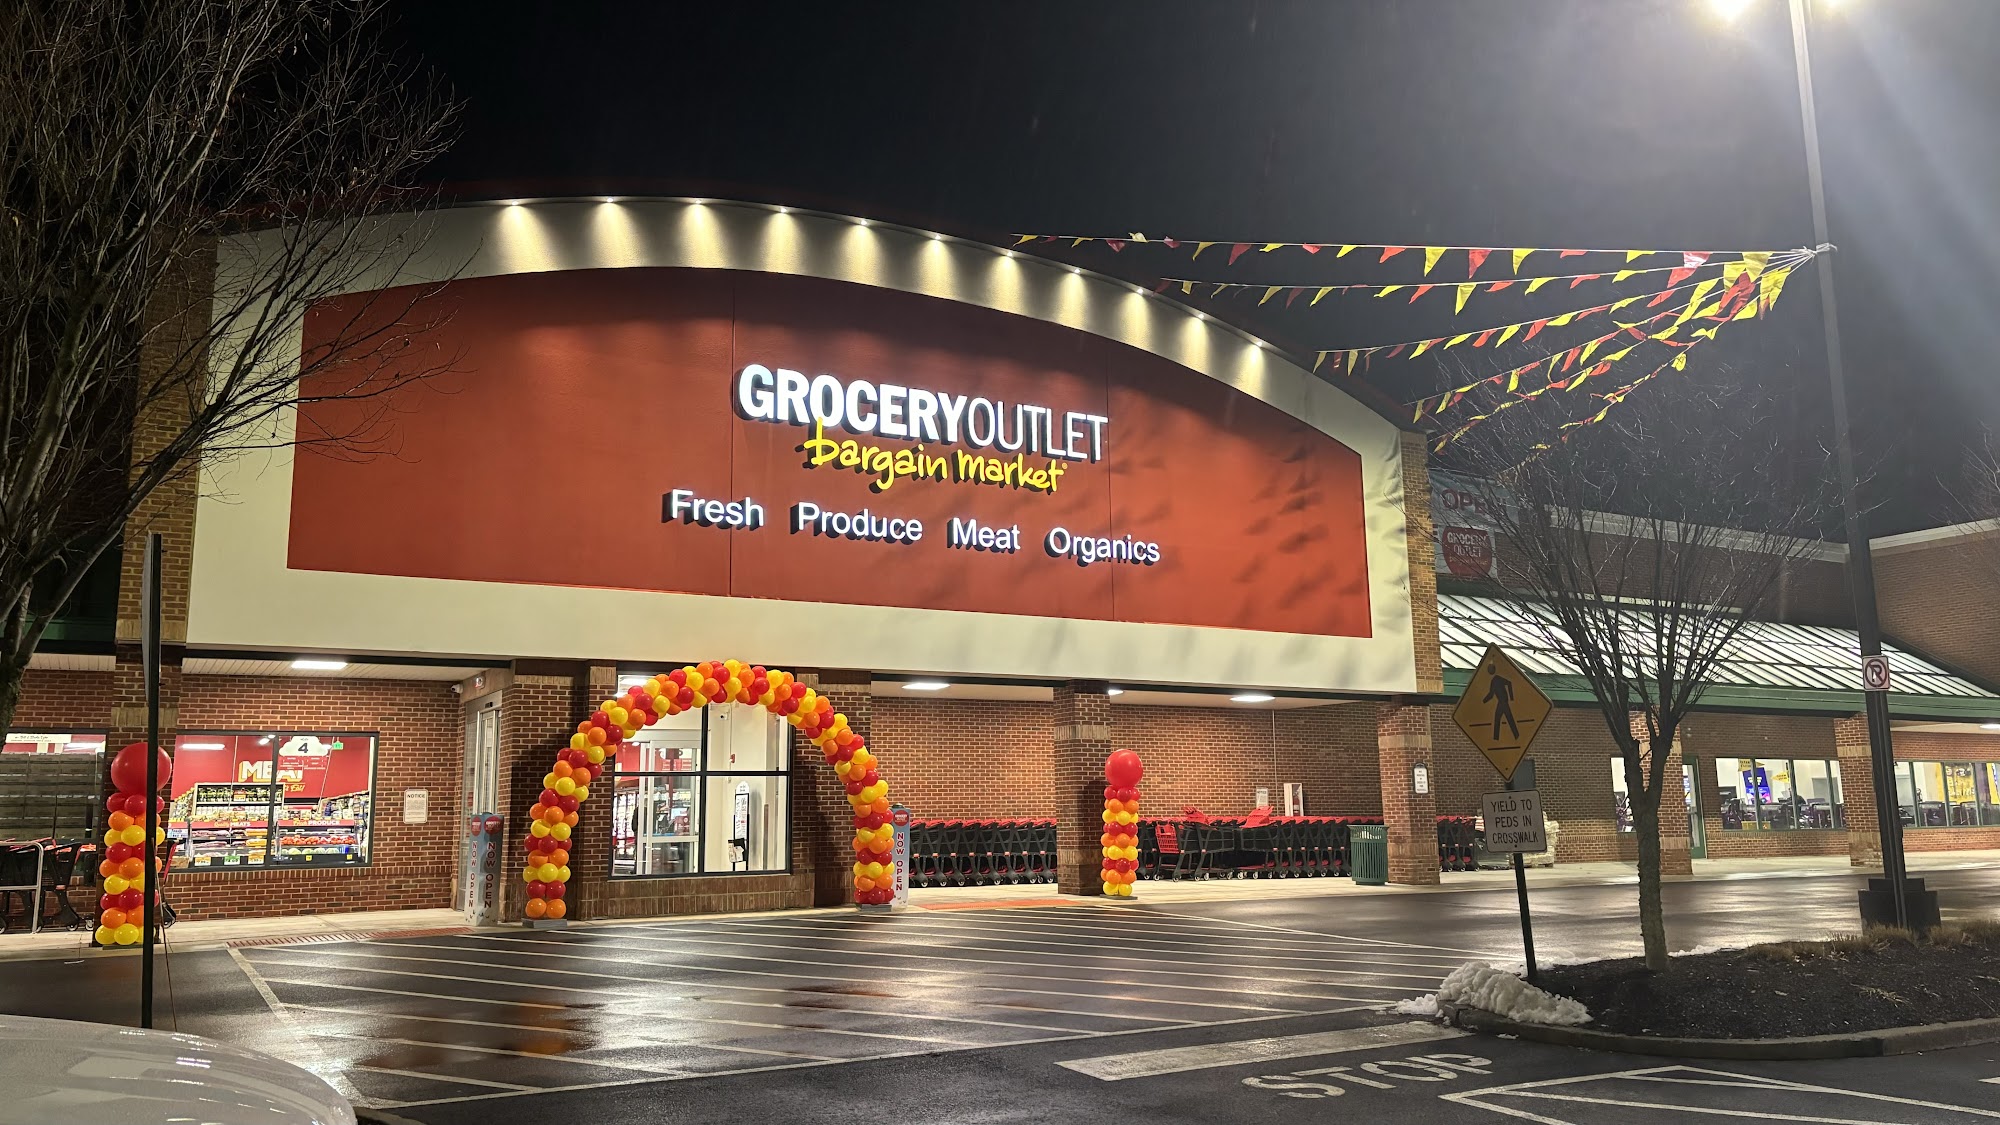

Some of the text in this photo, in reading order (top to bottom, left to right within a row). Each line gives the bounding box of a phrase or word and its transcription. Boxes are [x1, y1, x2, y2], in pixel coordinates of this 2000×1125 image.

[803, 416, 1065, 492] bargain market
[671, 488, 1161, 564] Fresh Produce Meat Organics
[298, 742, 309, 754] 4
[1490, 799, 1533, 813] YIELD TO
[1495, 815, 1532, 828] PEDS IN
[896, 832, 905, 855] NOW
[1492, 831, 1539, 844] CROSSWALK
[486, 842, 496, 867] NOW
[895, 860, 904, 891] OPEN
[484, 873, 494, 908] OPEN
[1241, 1053, 1493, 1099] STOP
